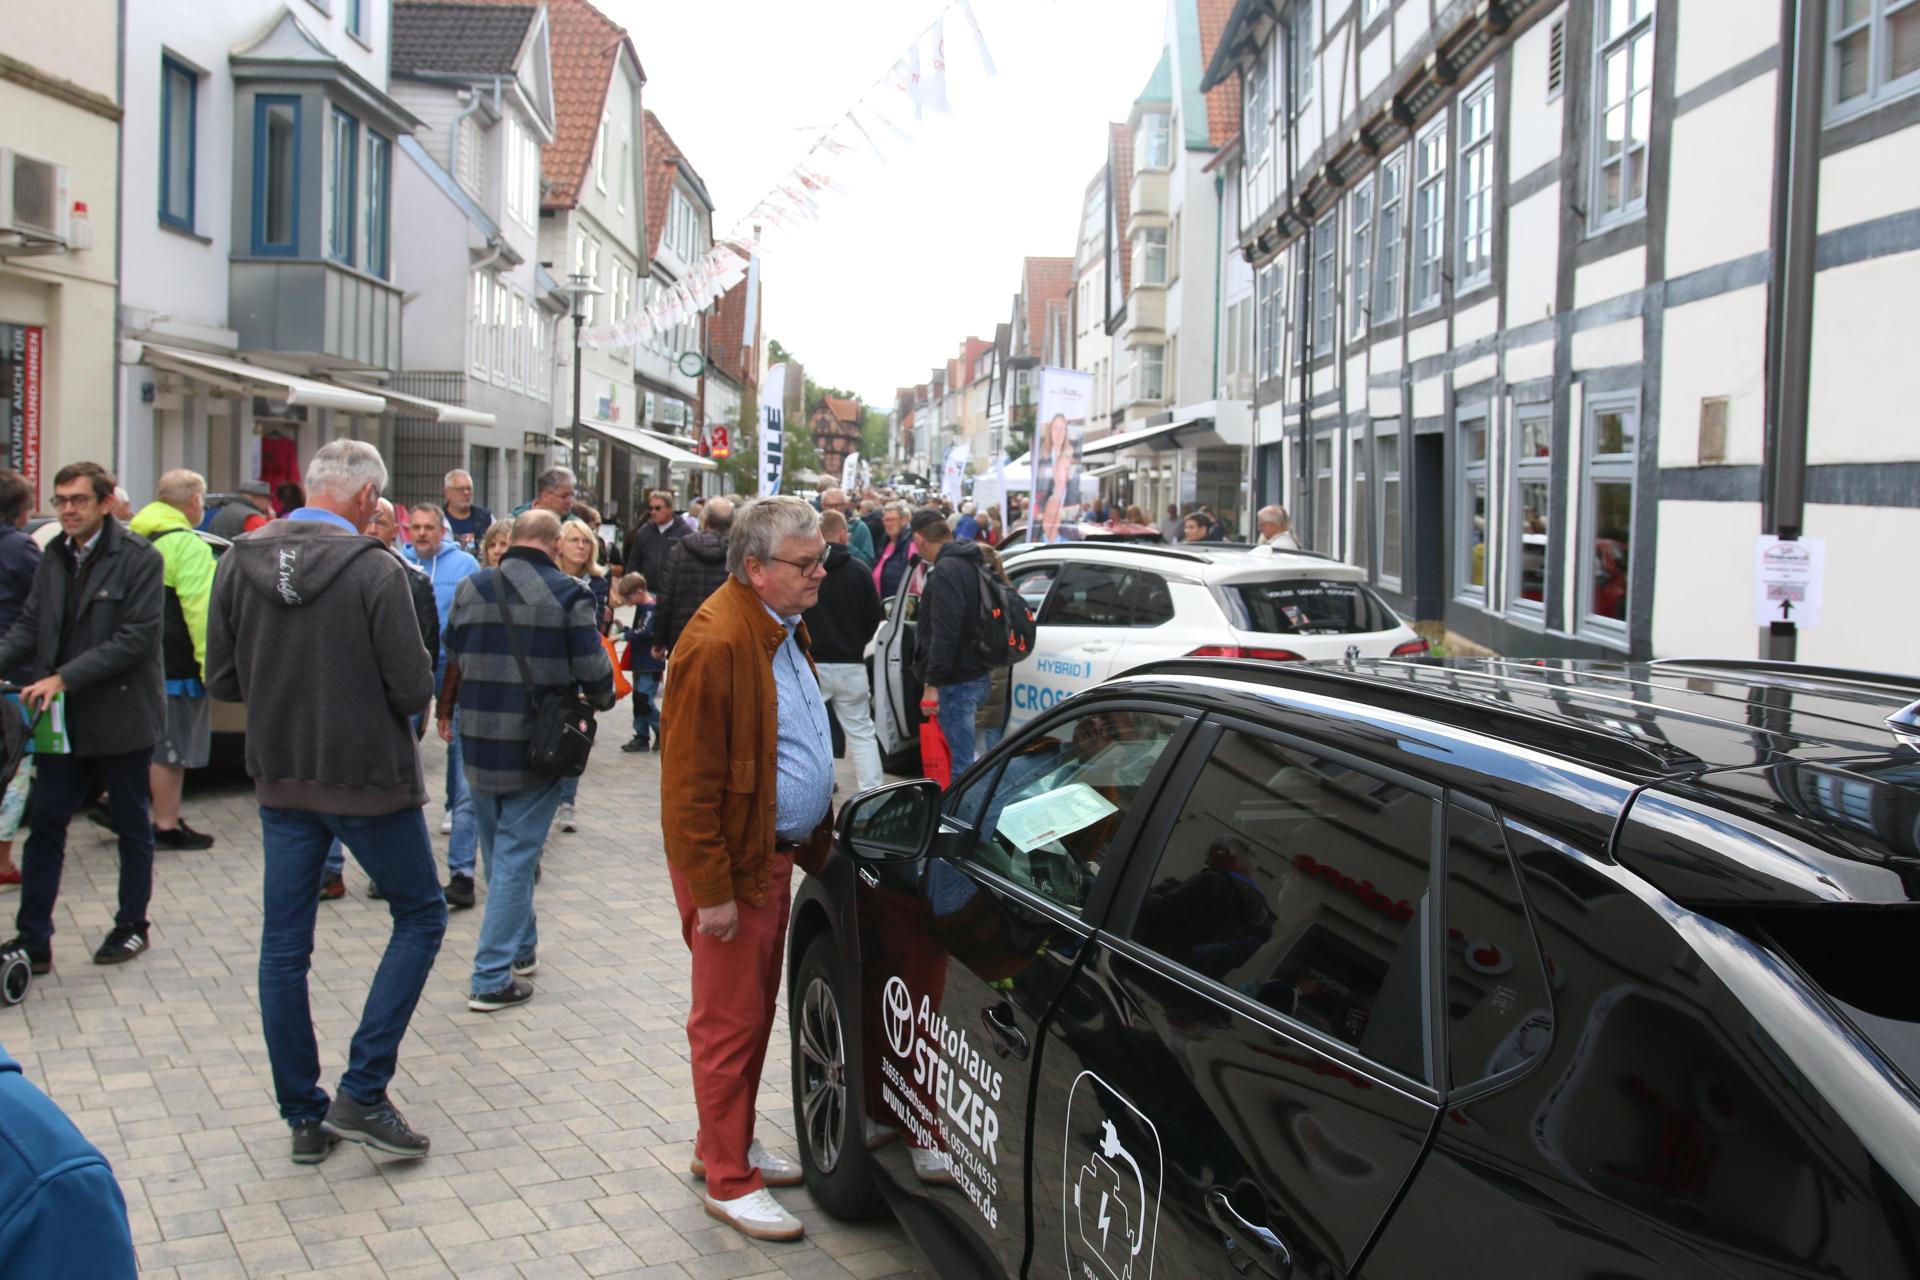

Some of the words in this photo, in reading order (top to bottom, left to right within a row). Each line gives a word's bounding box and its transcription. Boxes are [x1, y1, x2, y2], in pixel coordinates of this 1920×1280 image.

[12, 365, 24, 411] AUCH
[1036, 658, 1082, 677] HYBRID
[913, 1037, 999, 1166] STELZER
[917, 994, 1003, 1102] Autohaus
[881, 1055, 900, 1087] 31655
[899, 1075, 934, 1126] Stadthagen
[938, 1117, 950, 1145] Tel.
[949, 1132, 998, 1196] 05721/4515
[882, 1081, 999, 1230] www.toyota-stelzer.de
